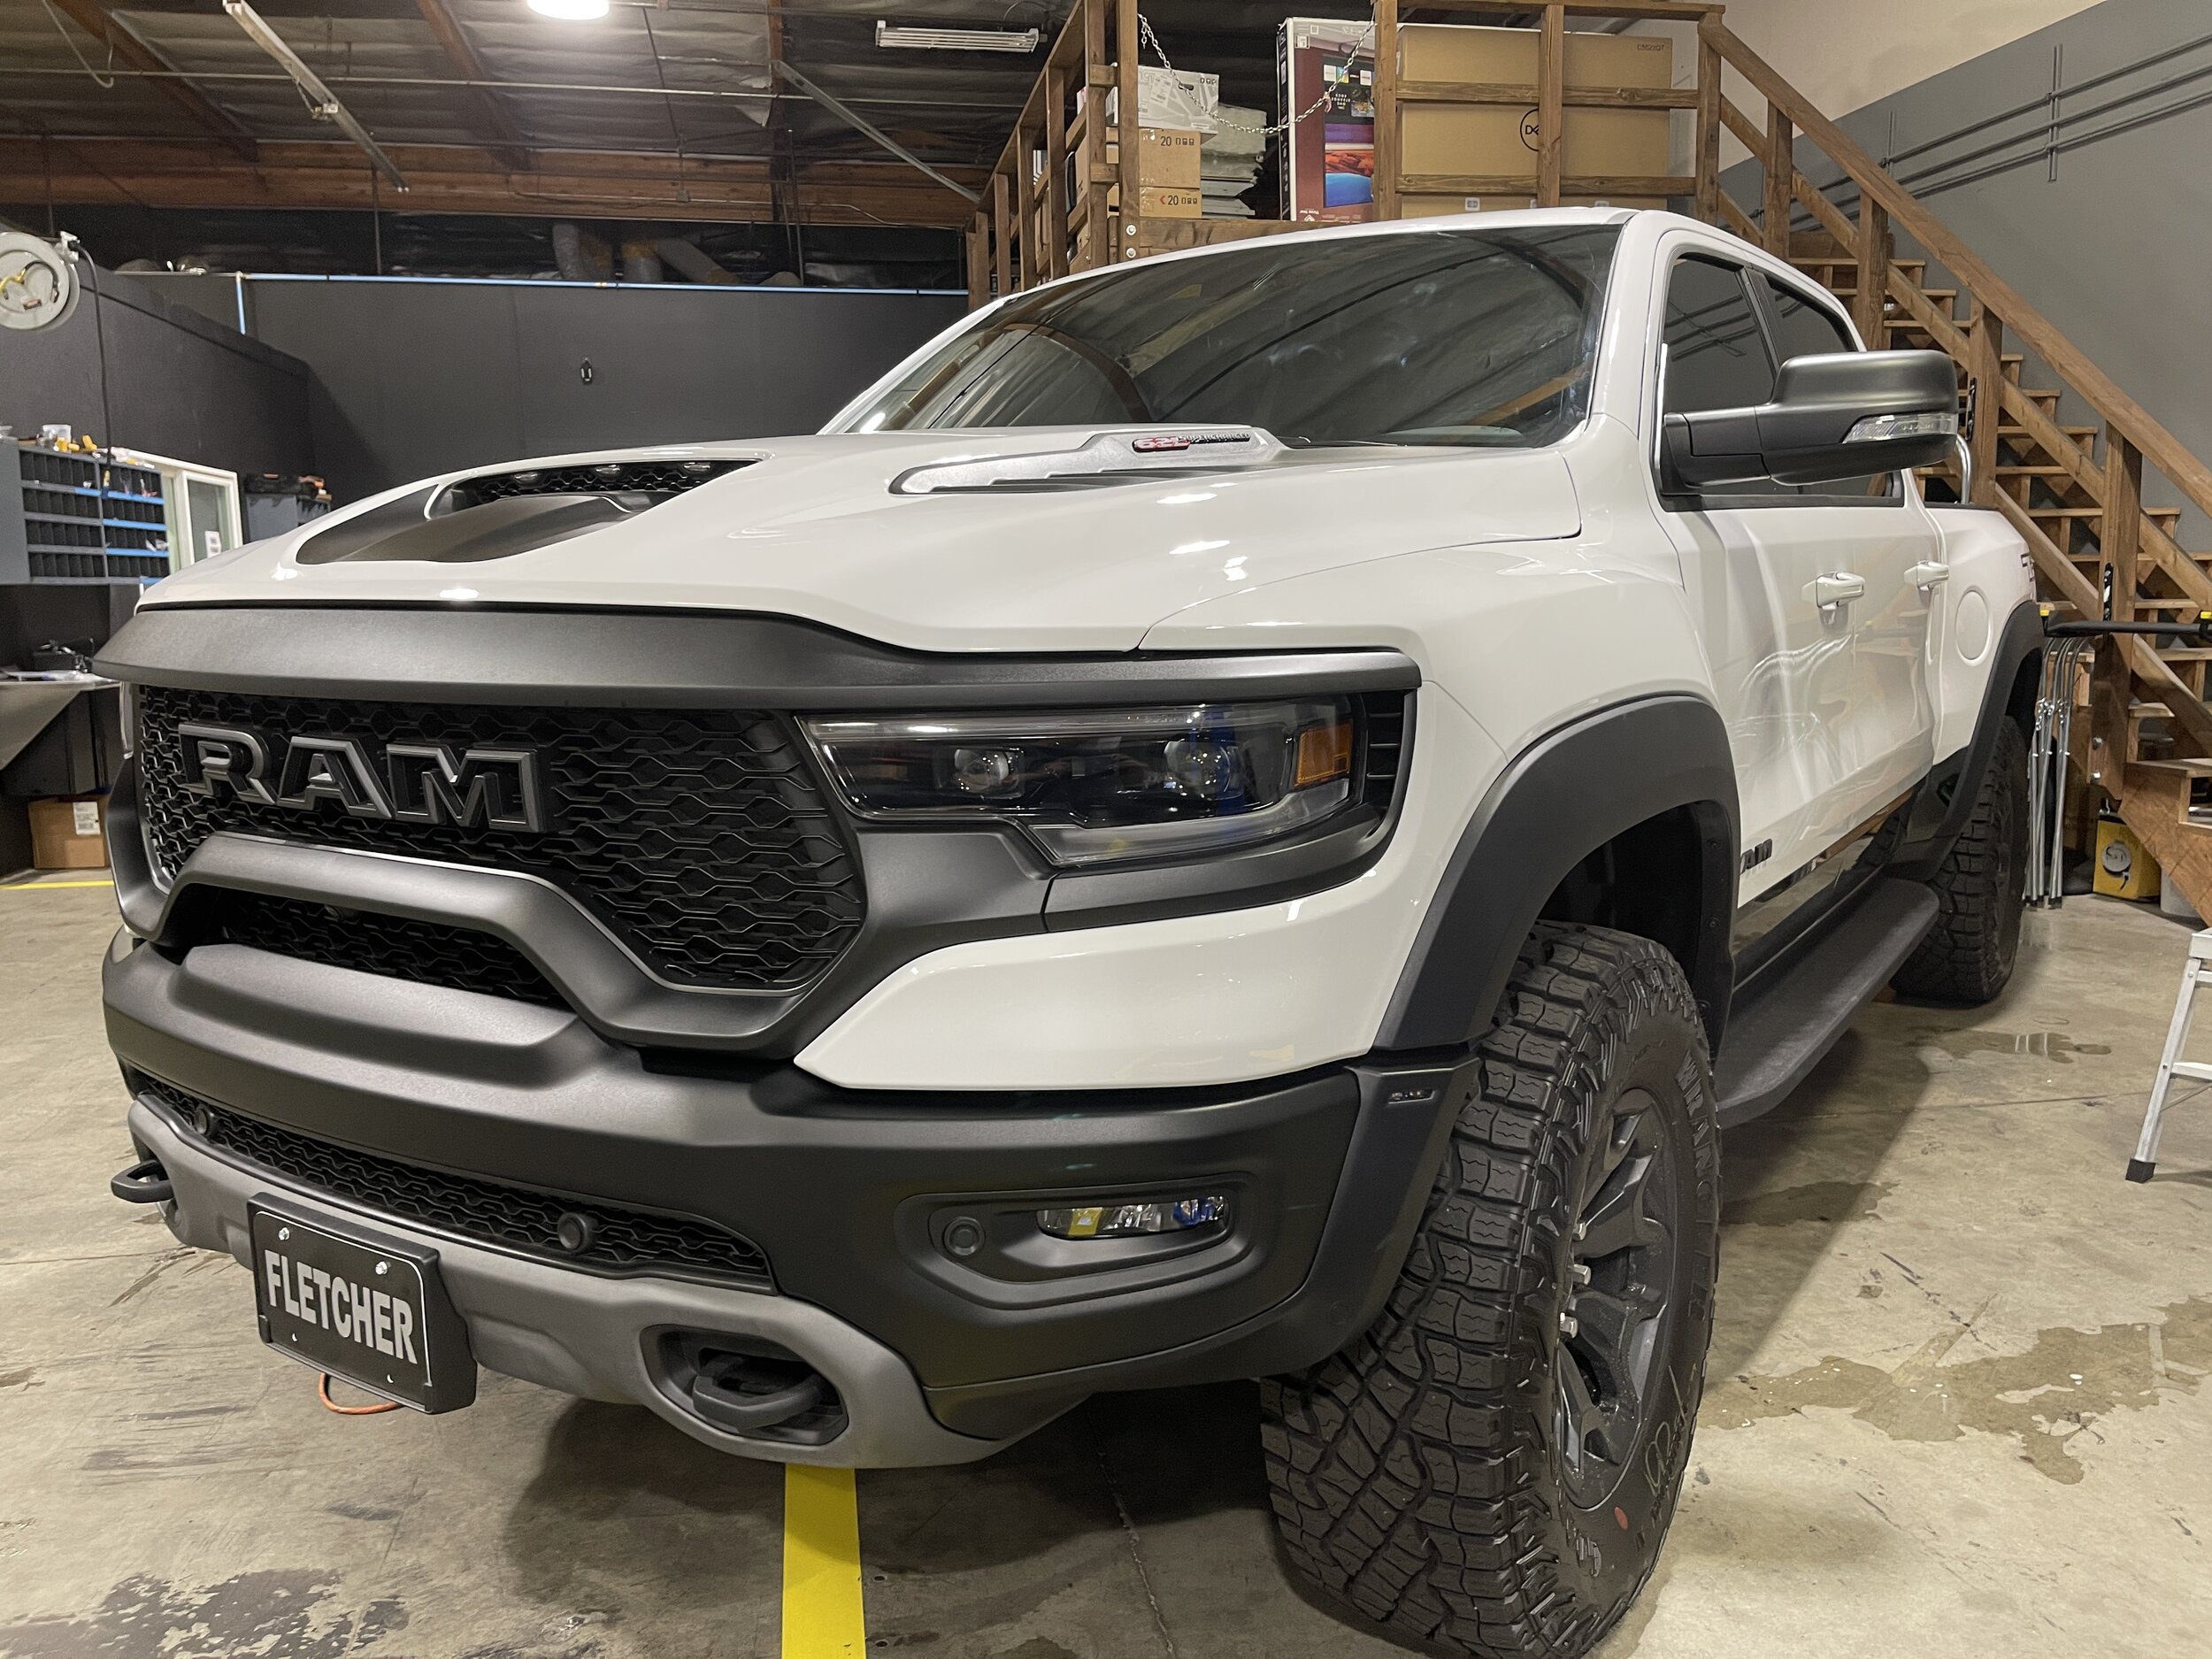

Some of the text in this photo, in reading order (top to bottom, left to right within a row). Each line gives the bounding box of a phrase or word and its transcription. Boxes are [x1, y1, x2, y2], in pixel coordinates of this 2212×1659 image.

[1160, 135, 1172, 147] 20
[1167, 195, 1179, 206] 20
[179, 723, 546, 833] RAM
[1740, 838, 1772, 874] AM
[265, 1249, 418, 1364] FLETCHER
